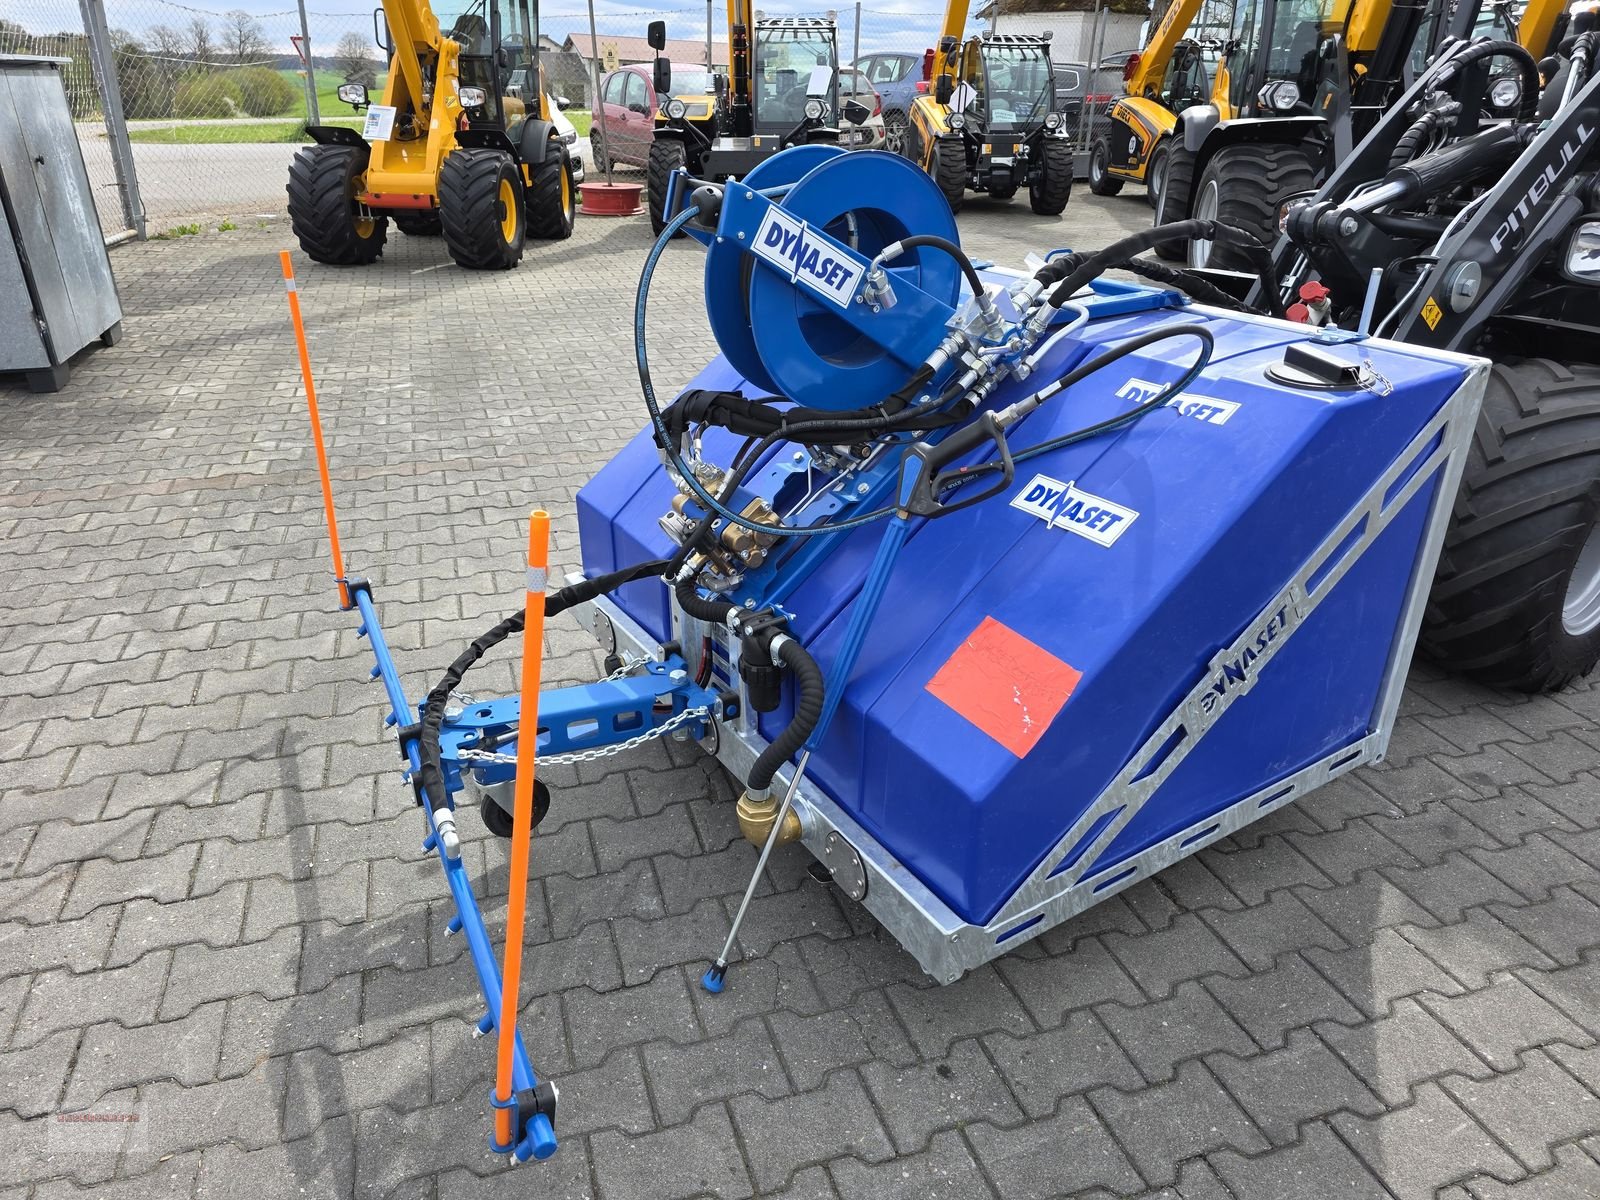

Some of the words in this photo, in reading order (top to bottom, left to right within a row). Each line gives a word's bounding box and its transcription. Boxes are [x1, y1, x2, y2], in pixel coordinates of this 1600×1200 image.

[1490, 123, 1595, 254] PITBULL
[763, 221, 854, 292] DYNASET
[1123, 386, 1226, 423] DYASET
[1023, 483, 1125, 533] DYNASET
[1200, 604, 1288, 714] DYNASET
